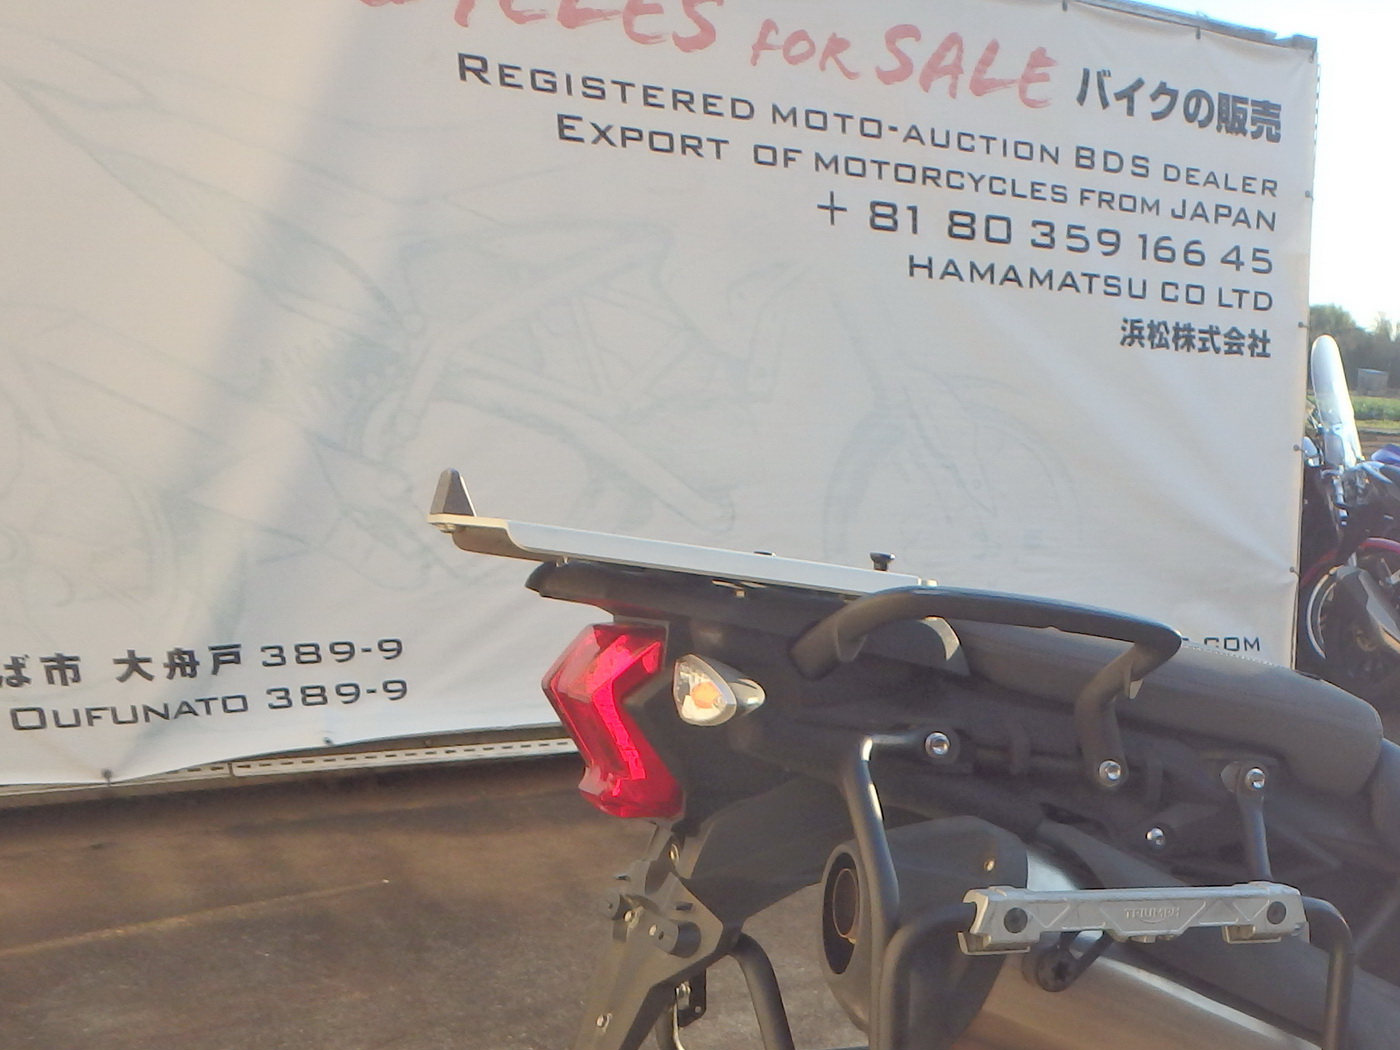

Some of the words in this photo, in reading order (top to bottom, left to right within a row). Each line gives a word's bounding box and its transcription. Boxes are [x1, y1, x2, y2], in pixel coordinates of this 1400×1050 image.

[875, 24, 1058, 109] SALE
[458, 52, 755, 121] REGISTERED
[771, 103, 1060, 165] MOTO-AUCTION
[1075, 145, 1150, 179] BDS
[1163, 163, 1278, 198] DEALER
[1076, 67, 1282, 144] バイクの販売
[557, 113, 730, 160] EXPORT
[753, 144, 803, 169] OF
[814, 151, 1068, 204] MOTORCYCLES
[1079, 187, 1160, 216] FROM
[1170, 198, 1276, 232] JAPAN
[869, 200, 918, 235] 81
[947, 210, 1012, 245] 80
[1220, 244, 1273, 275] 45
[908, 254, 1147, 300] HAMAMATSU
[1160, 281, 1206, 306] CO
[1218, 287, 1273, 312] LTD
[1120, 317, 1272, 359] 浜松株式会社
[113, 643, 242, 683] 大舟戸
[260, 639, 403, 668] 389-9
[10, 694, 249, 731] OUFUNATO
[266, 679, 408, 710] 389-9
